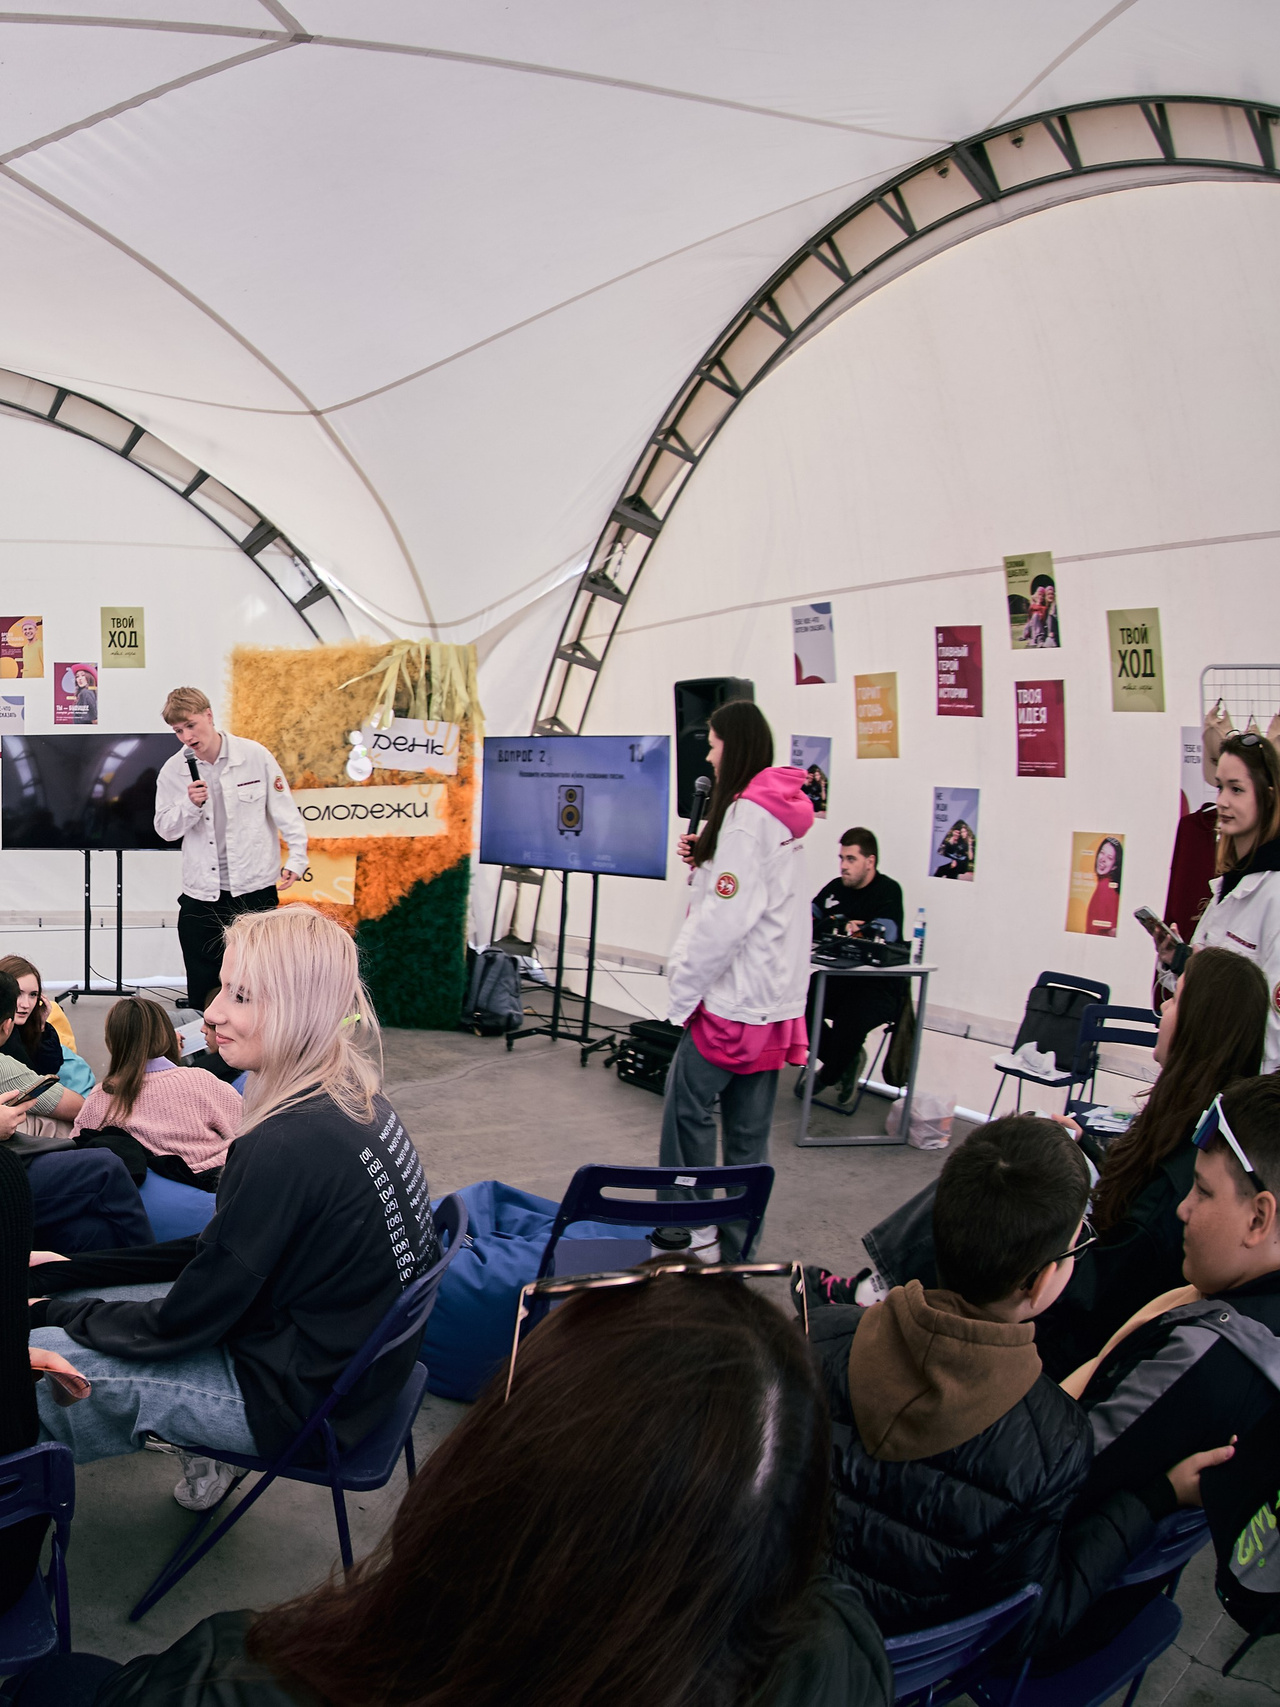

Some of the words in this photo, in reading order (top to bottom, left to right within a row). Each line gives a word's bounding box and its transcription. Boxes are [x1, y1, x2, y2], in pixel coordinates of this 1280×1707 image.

[111, 615, 135, 628] ТВОЙ
[108, 630, 139, 648] ХОД
[1119, 623, 1149, 645] ТВОЙ
[938, 658, 959, 671] ГЕРОЙ
[1117, 649, 1156, 679] ХОД
[938, 672, 956, 684] ЭТОЙ
[1017, 688, 1042, 704] ТВОЯ
[1018, 707, 1047, 724] ИДЕЯ
[498, 749, 533, 762] ВОПРОС
[540, 750, 546, 762] 2
[297, 802, 429, 821] олодежи
